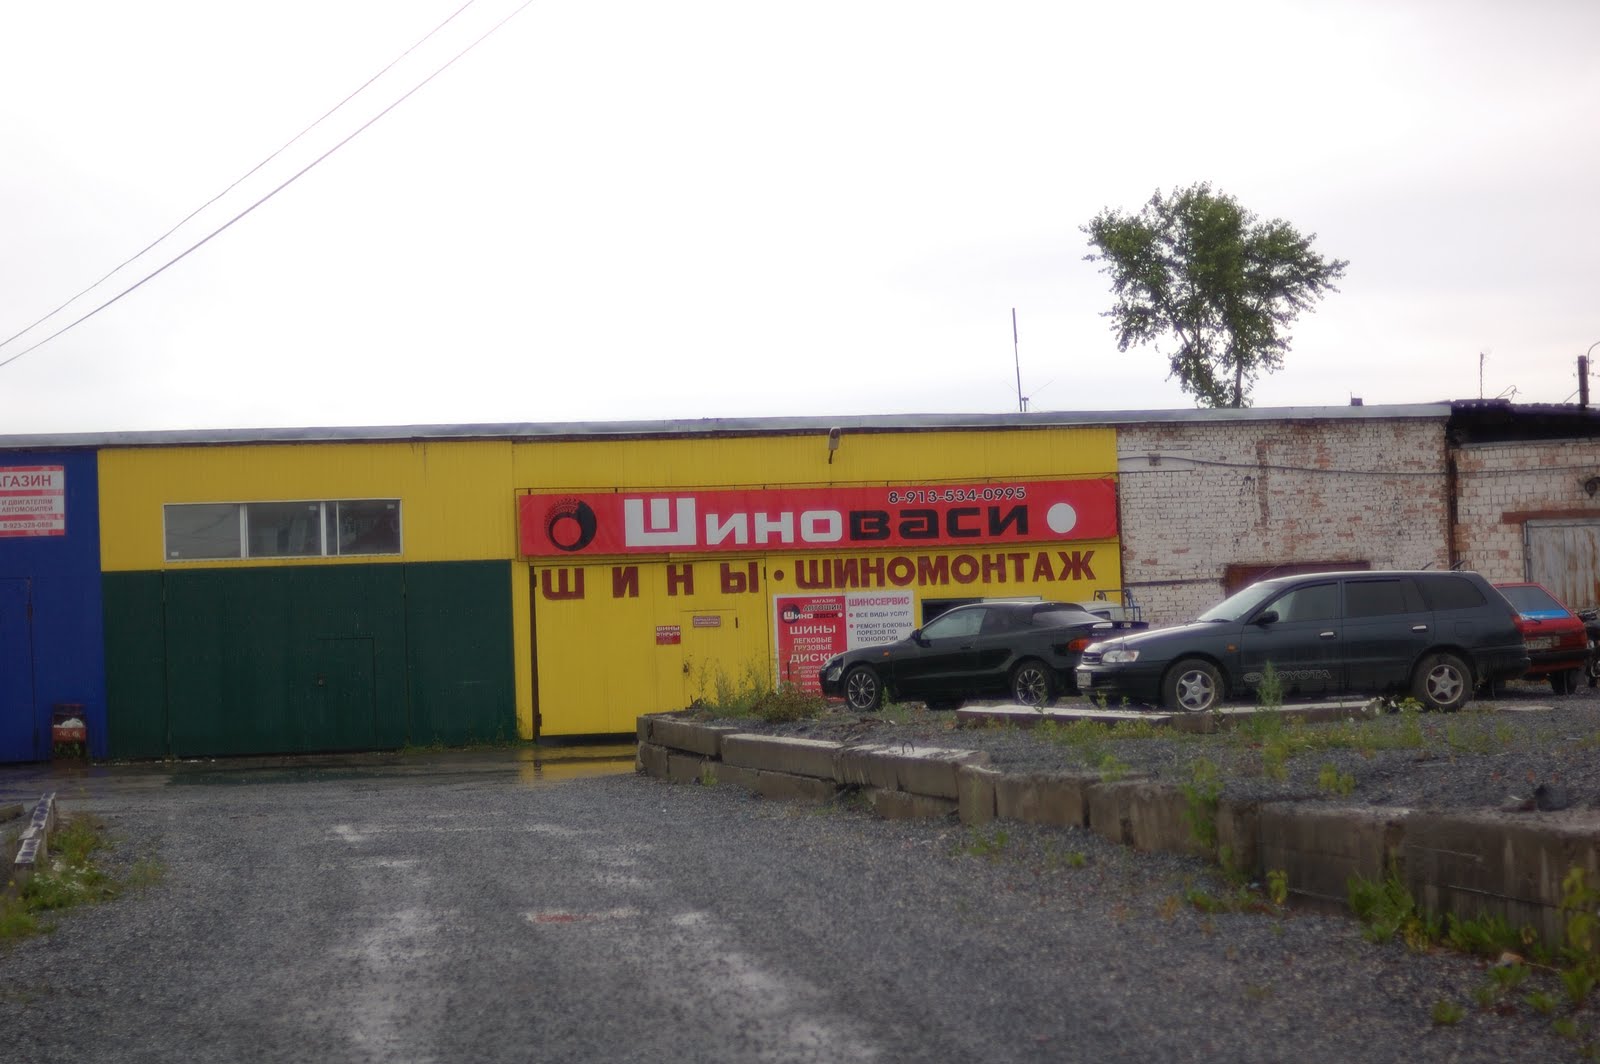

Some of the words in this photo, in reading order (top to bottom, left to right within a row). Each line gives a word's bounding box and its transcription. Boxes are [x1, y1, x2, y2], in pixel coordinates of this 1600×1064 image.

[0, 474, 52, 488] ГАЗИН
[888, 486, 1026, 504] 8-913-534-0995
[8, 498, 53, 506] ДВИГАТЕЛЯМ
[1, 505, 53, 513] АВТОМОБИЛЕЙ
[795, 550, 1097, 589] ШИНОМОНТАЖ
[848, 597, 910, 607] ШИНОСЕРВИС
[789, 625, 836, 635] ШИНЫ
[1272, 669, 1332, 680] OYOTA
